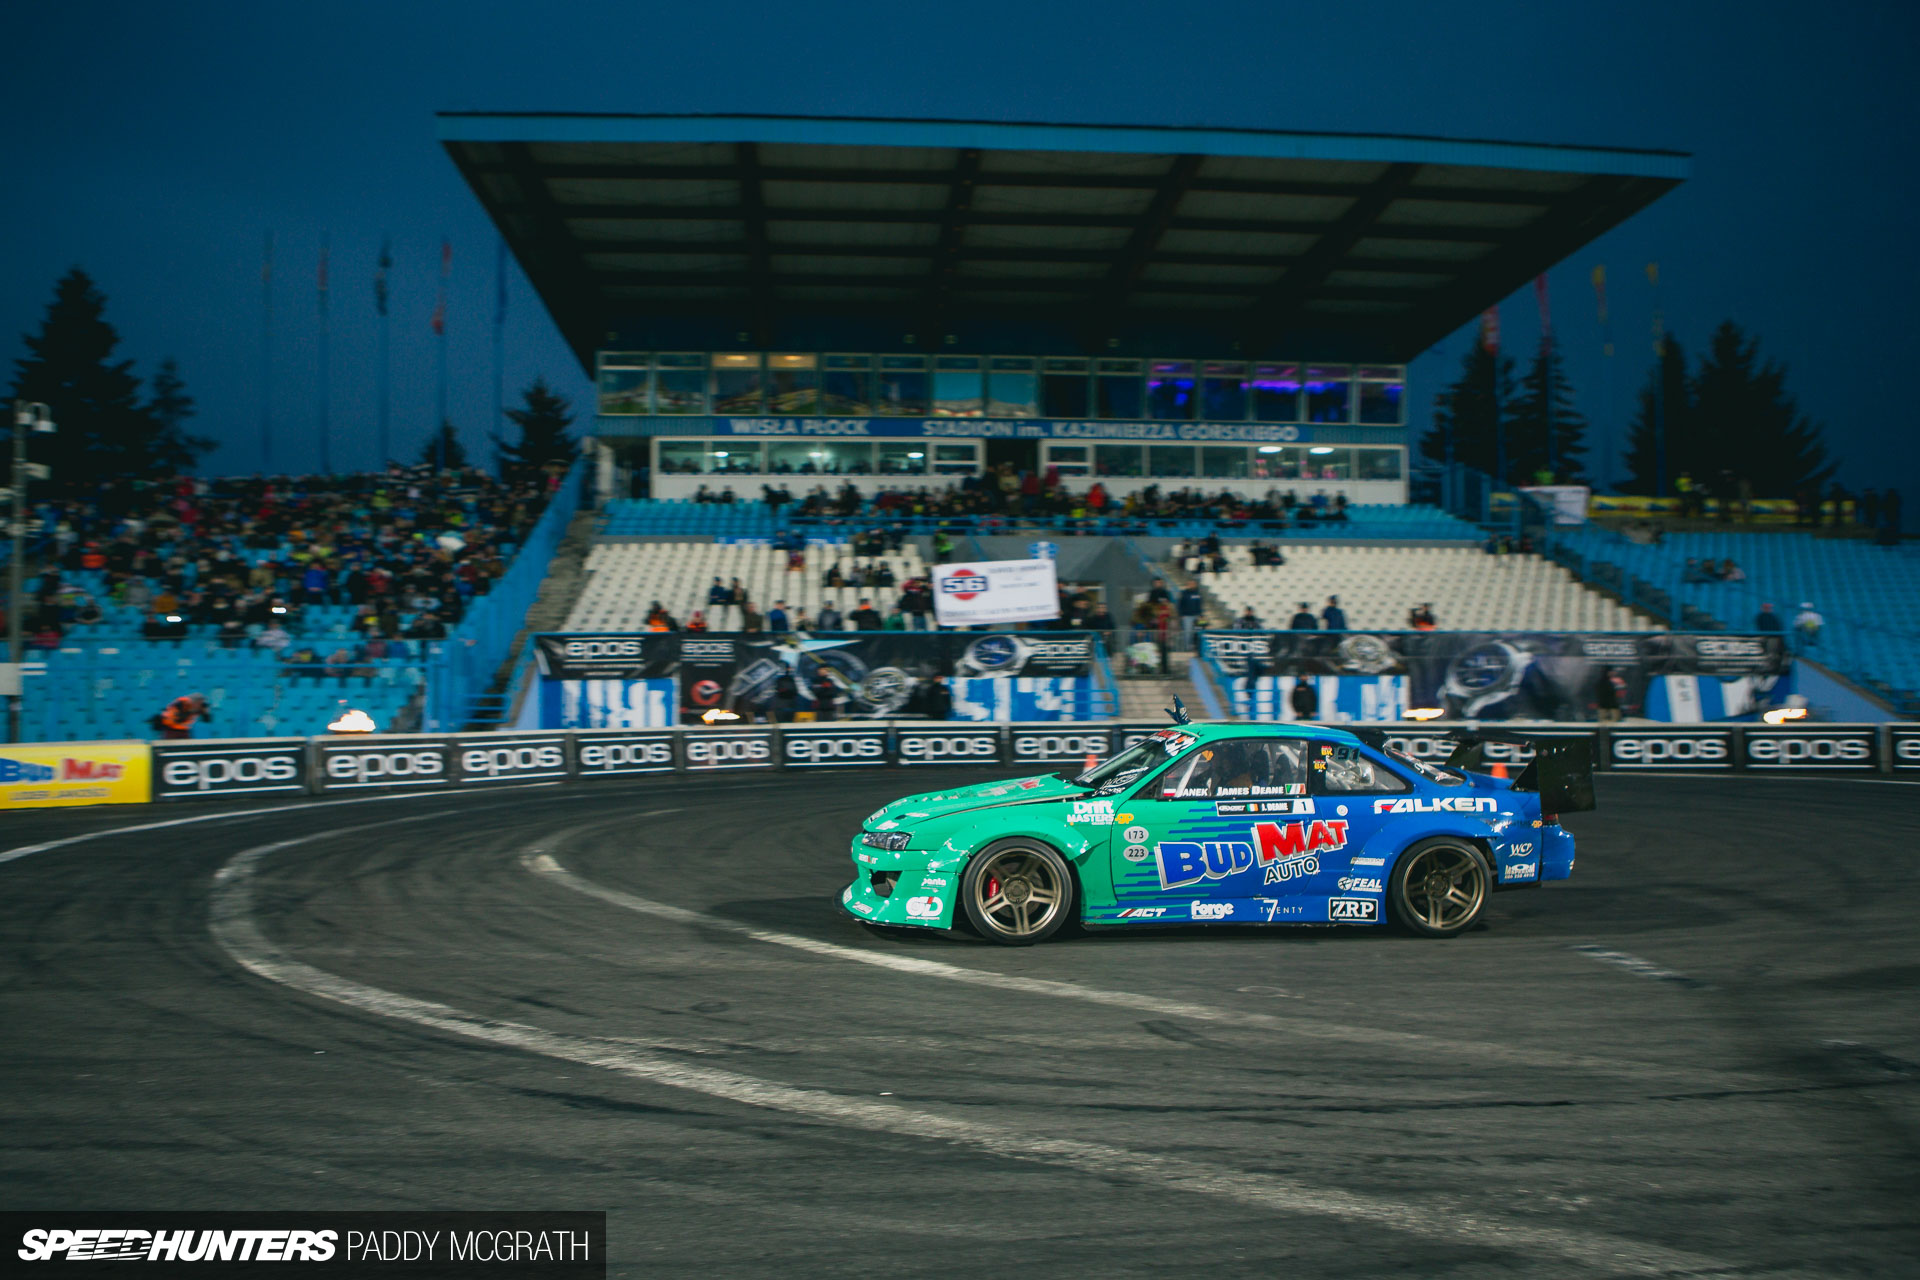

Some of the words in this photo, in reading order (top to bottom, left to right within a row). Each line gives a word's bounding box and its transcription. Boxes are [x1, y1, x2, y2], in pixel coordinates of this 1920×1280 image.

[921, 420, 1012, 436] STADION
[1052, 422, 1176, 438] KAZIMIERZA
[565, 642, 640, 659] epos
[580, 743, 670, 770] epos
[686, 740, 769, 765] epos
[786, 739, 881, 762] epos
[901, 737, 993, 760] epos
[1014, 736, 1108, 759] epos
[1613, 739, 1728, 763] epos
[1748, 739, 1871, 763] epos
[327, 752, 443, 783] epos
[462, 746, 562, 775] epos
[165, 757, 293, 789] epos
[1216, 786, 1250, 796] JAMES
[1251, 785, 1284, 795] DEANE
[1301, 801, 1307, 811] 1
[1374, 798, 1497, 814] FALKEN
[1128, 831, 1144, 840] 173
[1128, 849, 1145, 858] 223
[1154, 842, 1253, 890] BUD
[1251, 820, 1349, 867] MAT
[1264, 857, 1321, 885] AUTO
[1353, 878, 1382, 888] FEAL
[1131, 908, 1166, 917] ACT
[1332, 900, 1374, 918] ZRP
